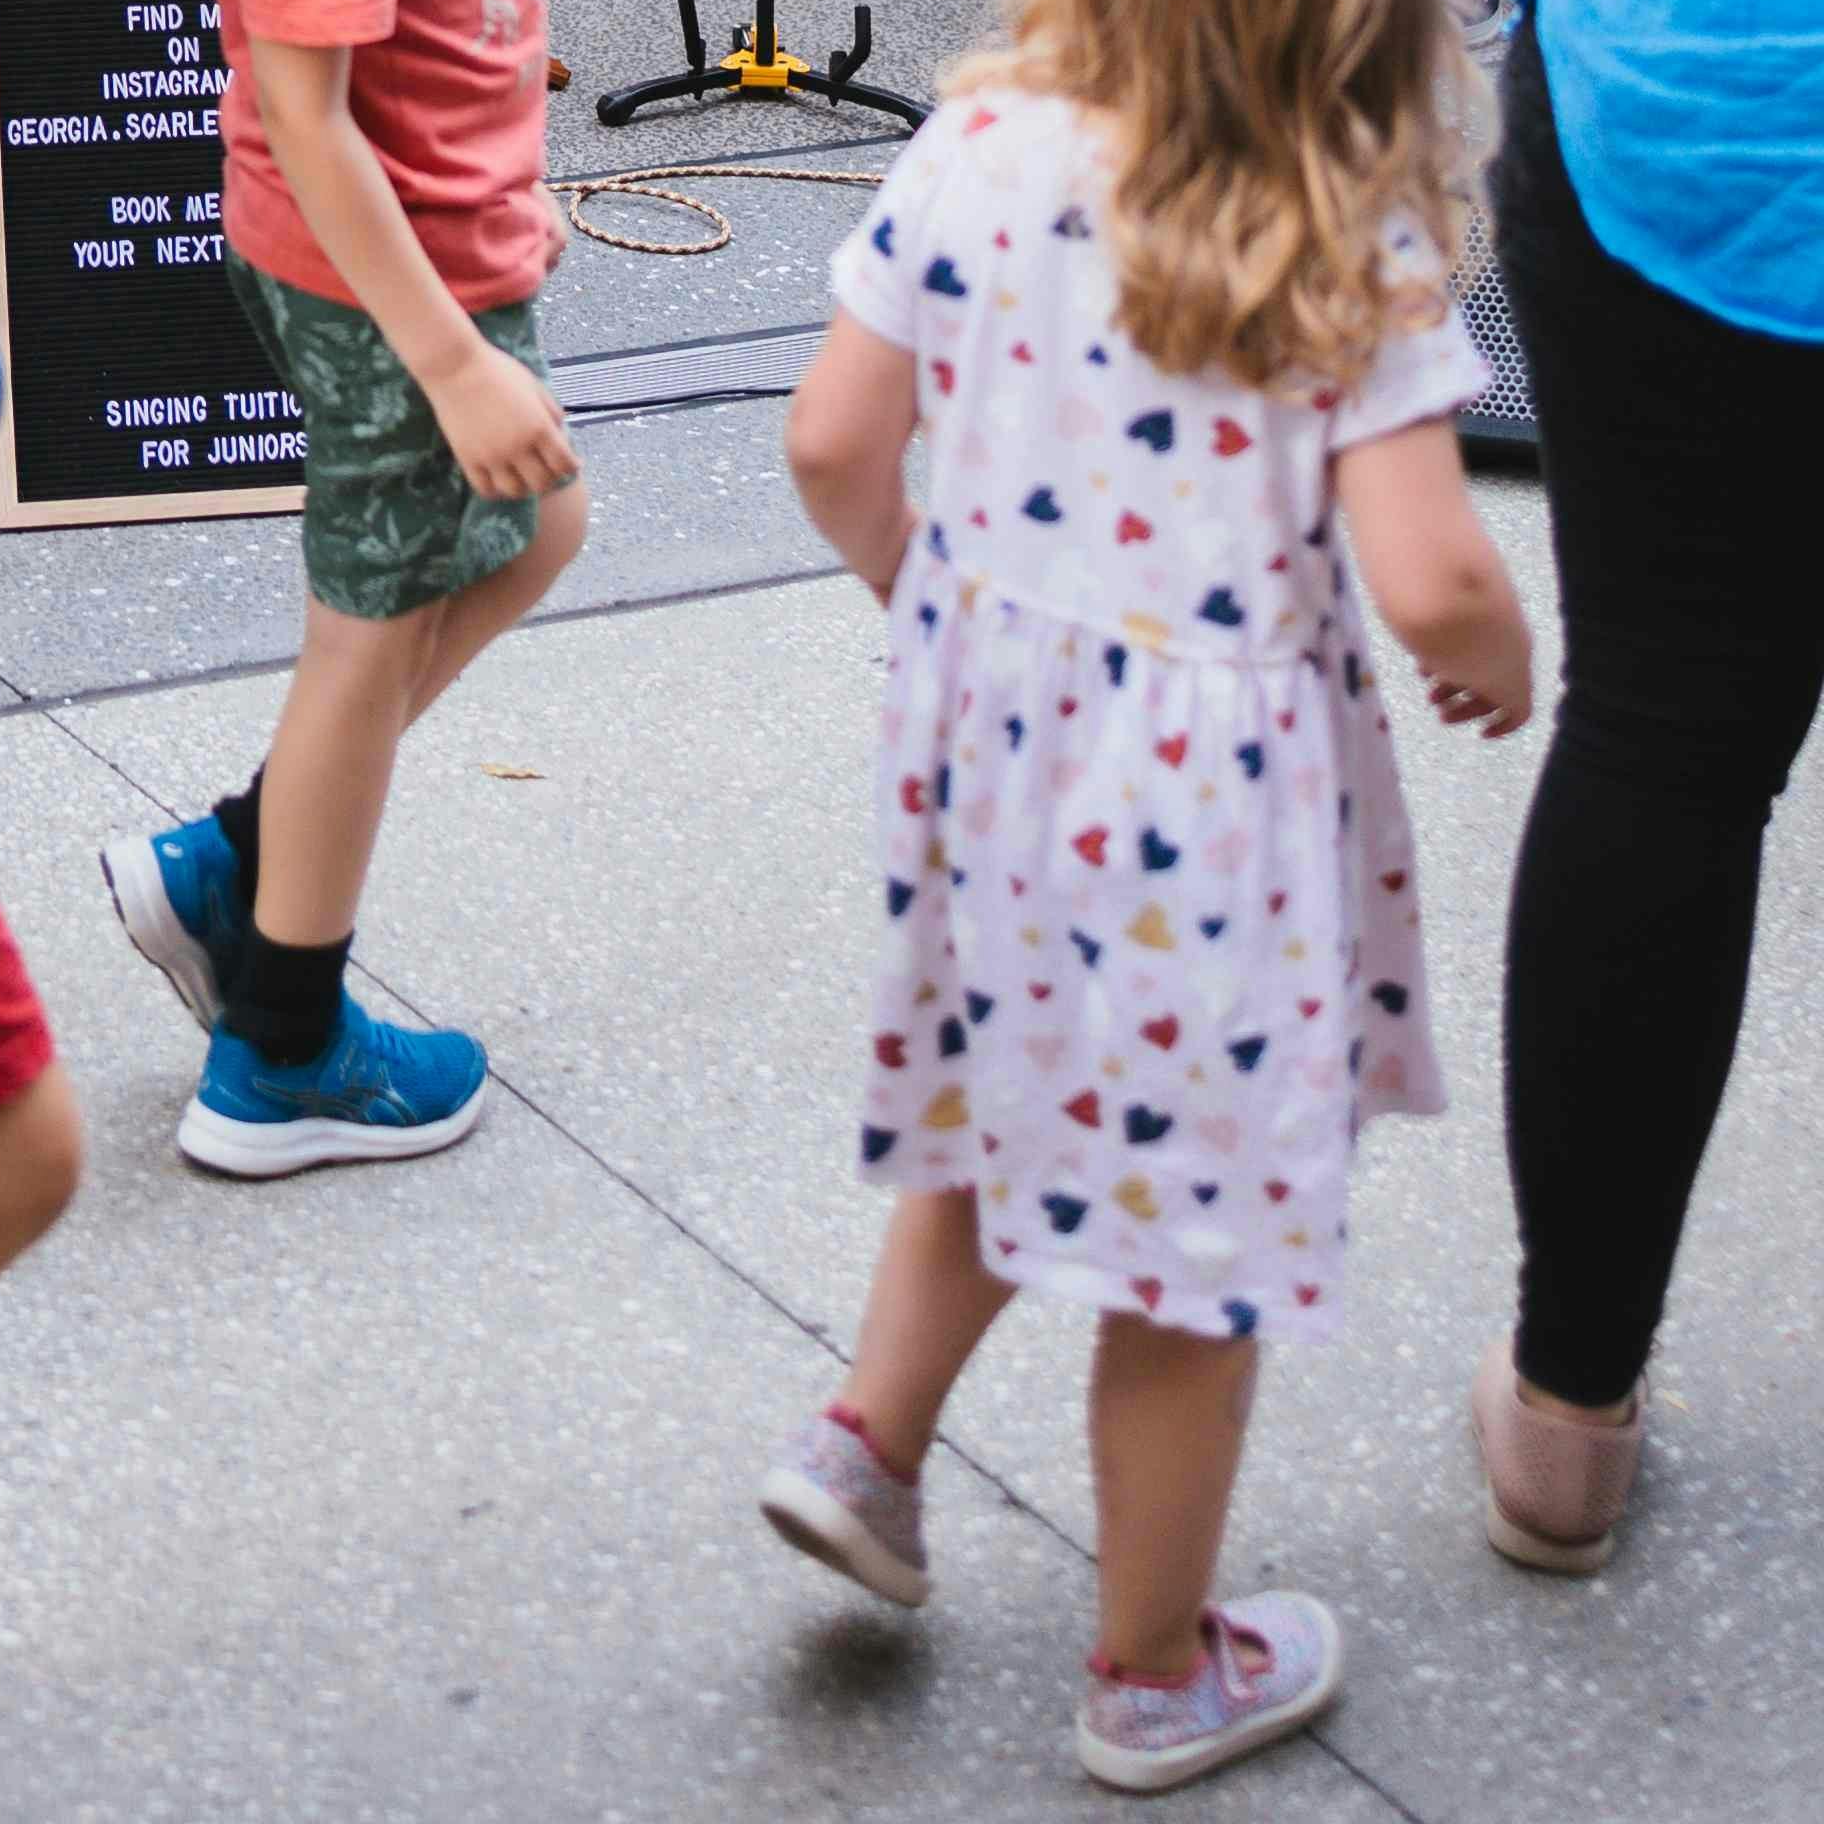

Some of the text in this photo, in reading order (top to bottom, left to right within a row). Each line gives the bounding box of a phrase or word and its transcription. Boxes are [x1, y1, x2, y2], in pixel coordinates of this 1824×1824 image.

[126, 3, 222, 32] FIND M
[167, 35, 200, 64] ON
[102, 68, 235, 100] INSTAGRAM
[7, 109, 222, 146] GEORGIA.SCARLE
[110, 191, 222, 224] BOOK ME
[73, 234, 225, 269] YOUR NEXT
[105, 395, 208, 428] SINGING
[141, 431, 310, 470] FOR JUNIORS
